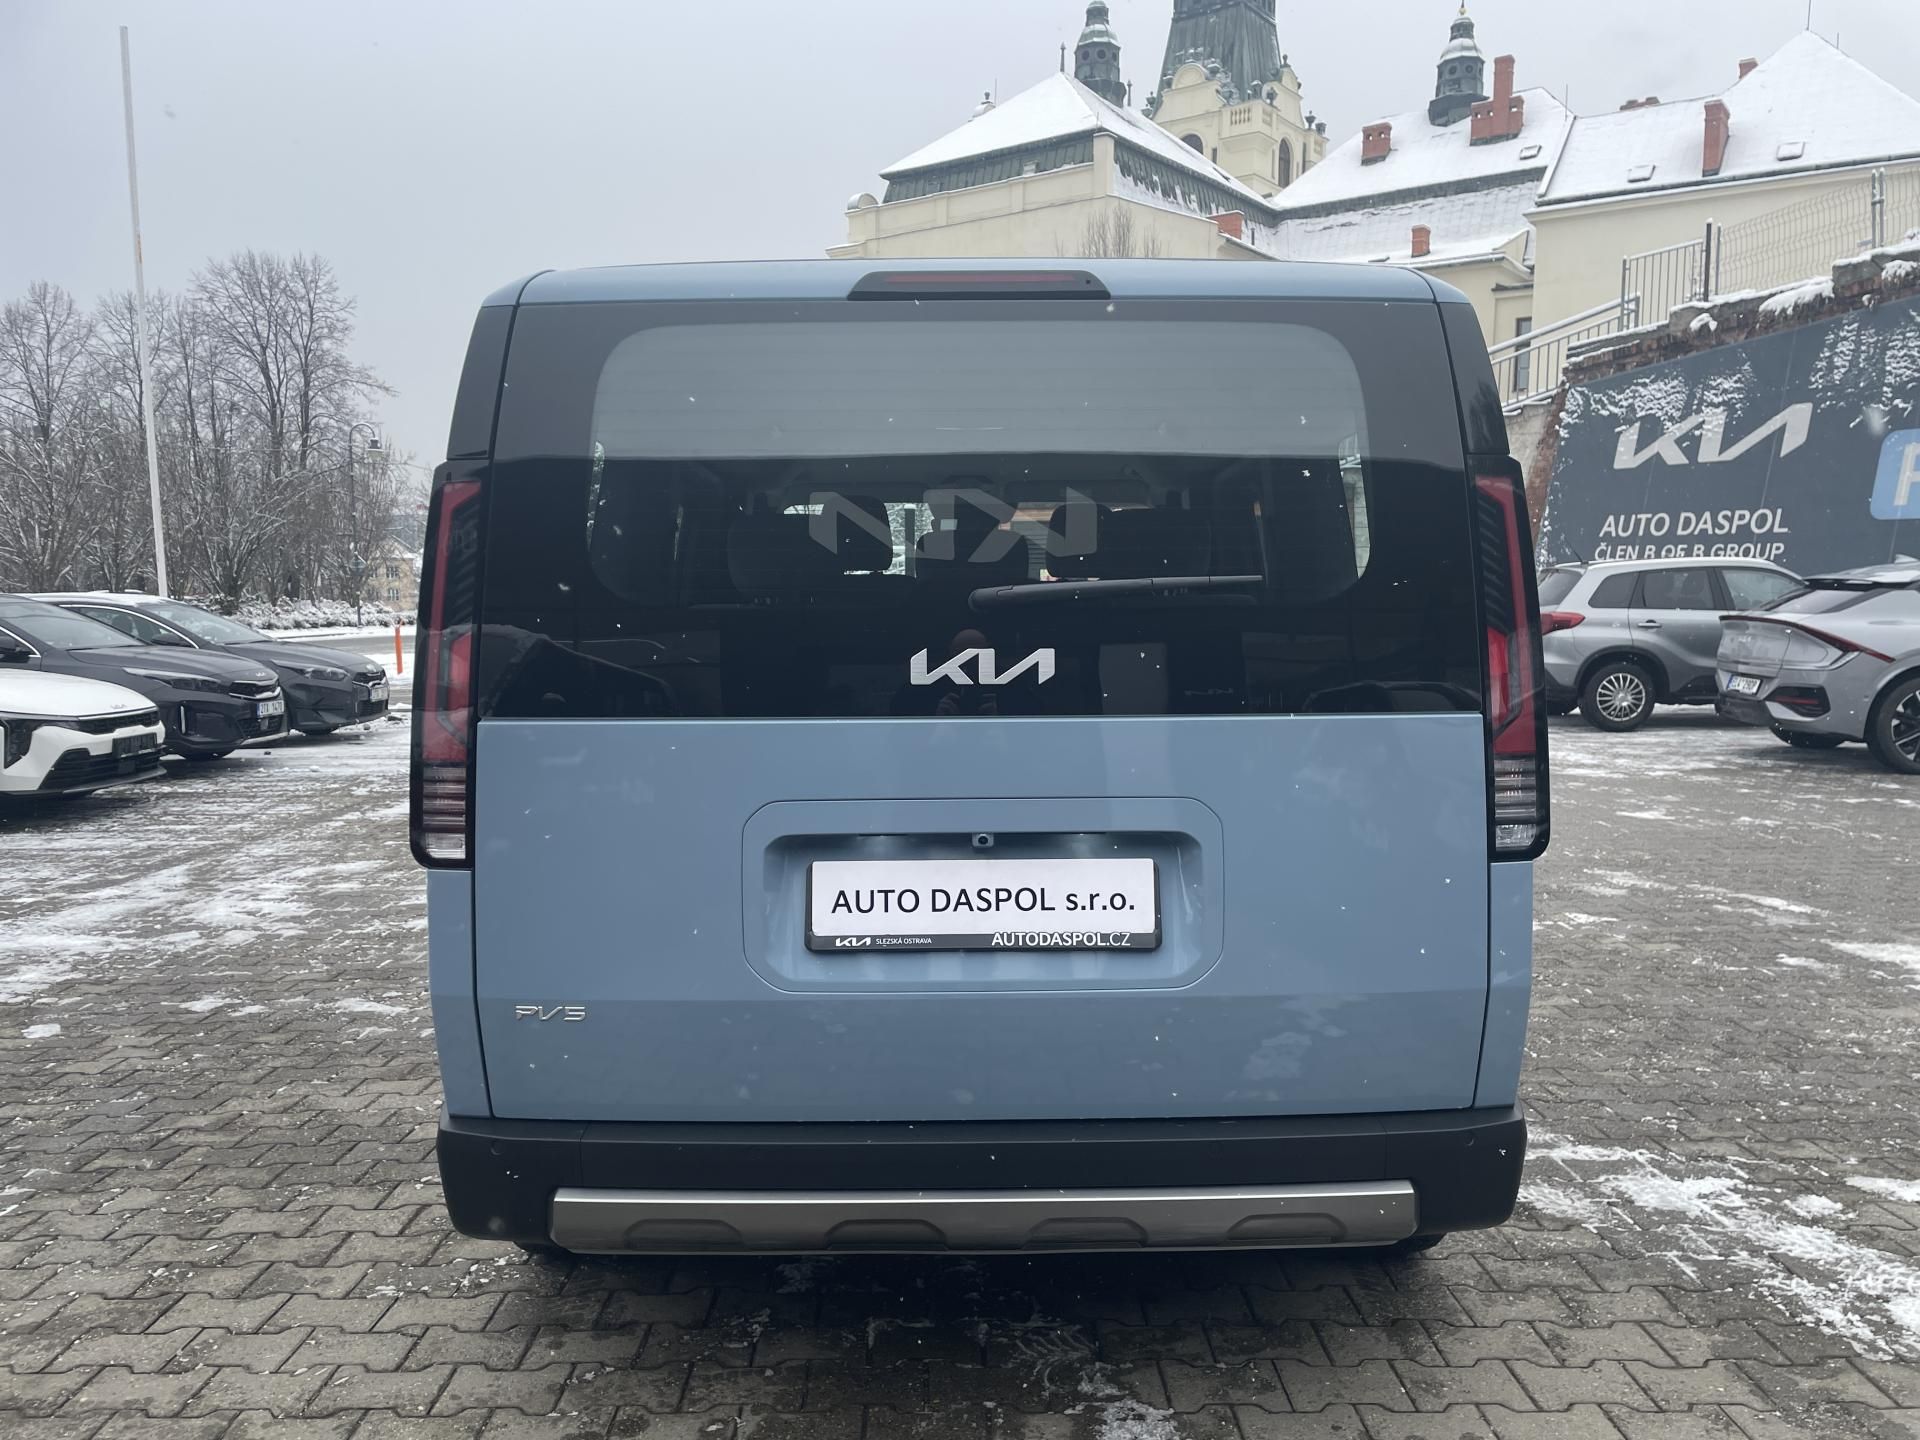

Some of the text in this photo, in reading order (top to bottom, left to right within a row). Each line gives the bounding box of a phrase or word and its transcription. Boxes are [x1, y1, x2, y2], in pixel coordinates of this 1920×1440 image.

[1613, 402, 1813, 469] KIA
[1599, 508, 1789, 537] AUTO DASPOL
[1594, 542, 1639, 560] ČLEN
[1710, 542, 1785, 560] GROUP
[911, 648, 1055, 685] KIA
[831, 887, 1135, 914] AUTO DASPOL s.r.o.
[835, 937, 871, 947] KIA
[875, 937, 902, 945] SLEZSKÁ
[991, 931, 1132, 947] AUTODASPOL.CZ
[515, 1005, 586, 1021] PV5
